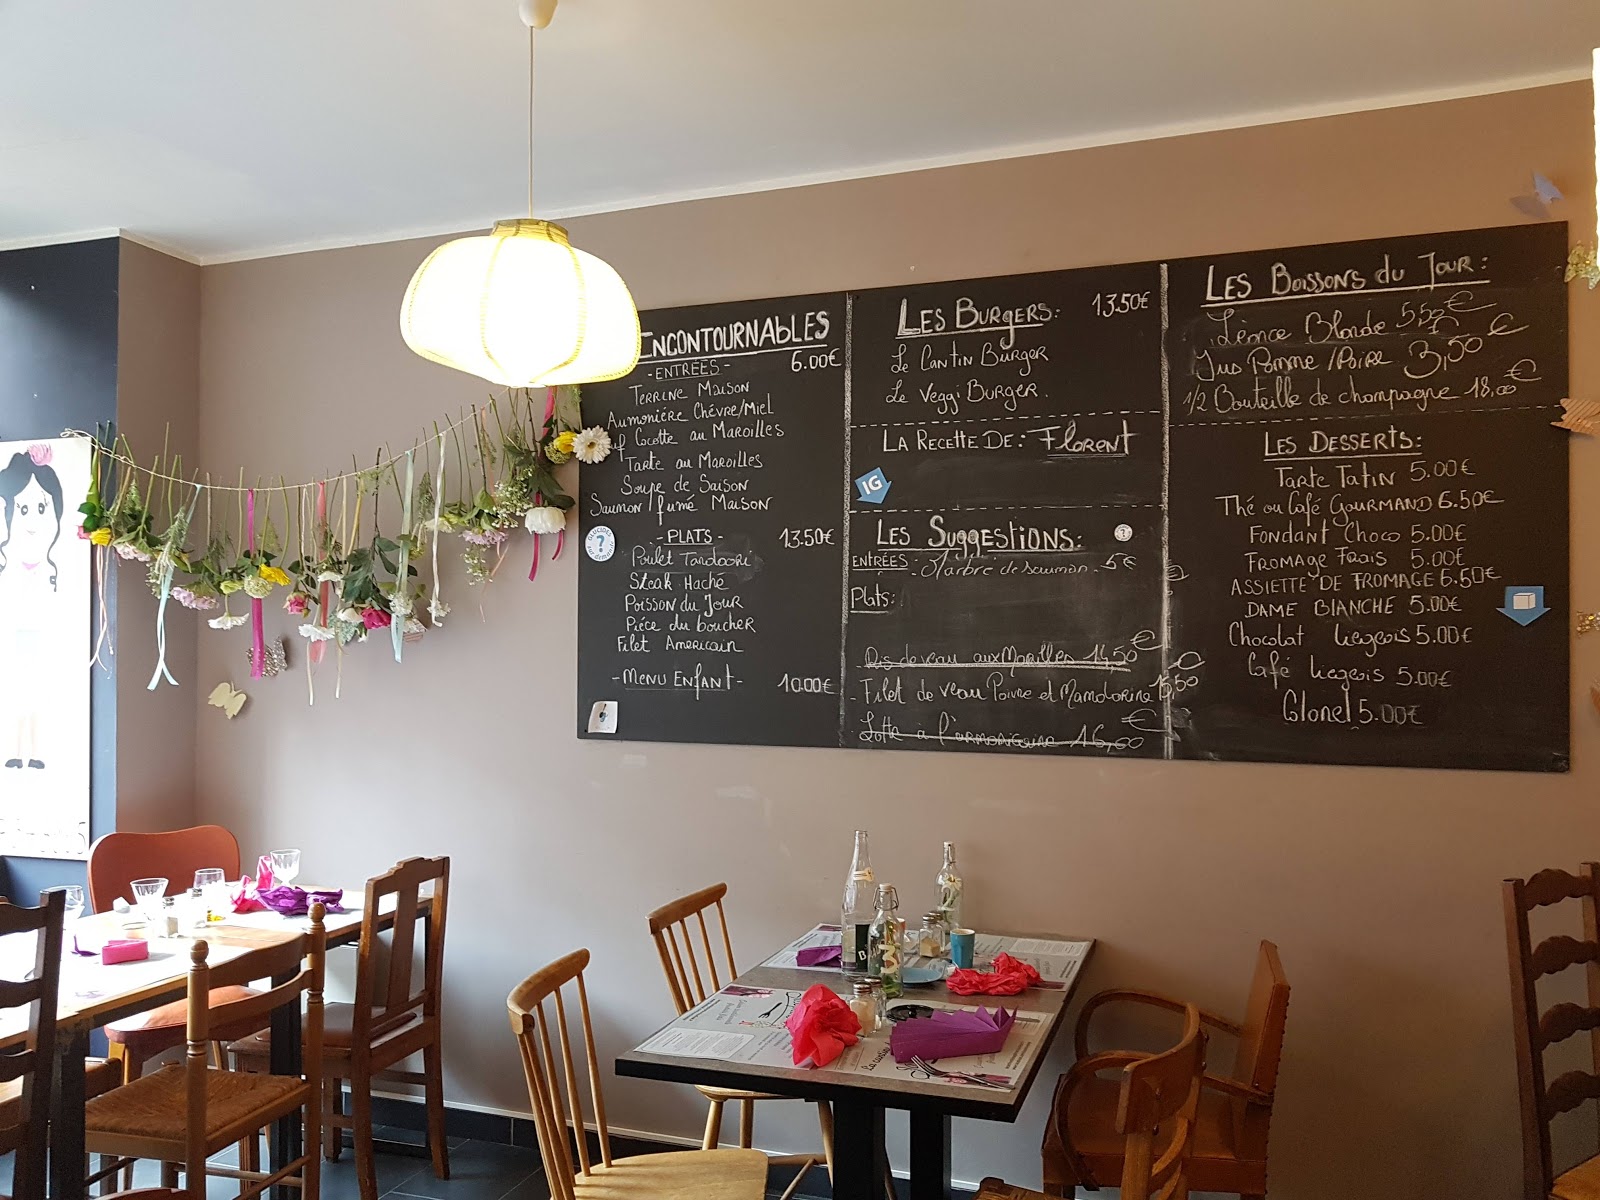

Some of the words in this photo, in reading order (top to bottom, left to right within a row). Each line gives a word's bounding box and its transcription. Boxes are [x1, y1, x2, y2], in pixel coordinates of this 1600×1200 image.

[1206, 264, 1251, 301] LES
[1271, 261, 1366, 295] Boissons
[1375, 253, 1405, 284] du
[897, 298, 945, 337] LES
[1305, 310, 1386, 344] Blonde
[791, 348, 841, 372] 6.00€
[891, 344, 909, 373] Le
[921, 341, 973, 371] Cantin
[981, 342, 1049, 376] Burger
[1196, 349, 1242, 381] Jus
[1247, 346, 1320, 375] Pomme
[698, 381, 750, 397] Maison
[886, 379, 908, 403] Le
[920, 383, 961, 415] Veggi
[1183, 391, 1206, 416] 1/2
[1213, 376, 1301, 414] Bouteille
[1309, 378, 1328, 405] de
[1338, 376, 1459, 412] champagne
[635, 428, 678, 446] Cocotte
[690, 431, 707, 441] au
[713, 421, 784, 439] Maroilles
[1265, 431, 1297, 456] LES
[624, 451, 664, 472] Tarte
[675, 458, 692, 469] au
[698, 451, 763, 469] Maroilles
[1274, 465, 1330, 489] Tarte
[1335, 461, 1396, 487] Tatin
[1409, 458, 1475, 482] 5.00€
[620, 475, 665, 511] Soupe
[673, 474, 690, 492] de
[700, 474, 749, 492] Saison
[862, 475, 883, 494] IG
[590, 493, 642, 517] Saumon
[657, 494, 698, 526] fumé
[711, 494, 773, 511] Maison
[1215, 494, 1255, 515] Thé
[1263, 502, 1285, 514] ou
[1288, 490, 1321, 526] Café
[1438, 489, 1504, 512] 6.50€
[779, 528, 835, 549] 13.50€
[876, 519, 910, 546] LES
[1249, 519, 1328, 544] Fondant
[1344, 521, 1401, 544] Choco
[1410, 523, 1467, 543] 5.00€
[632, 545, 674, 567] Poulet
[1410, 547, 1464, 568] 5.00€
[629, 572, 672, 590] Steak
[684, 572, 729, 590] Haché
[1231, 577, 1307, 597] ASSIETTE
[1320, 576, 1342, 592] DE
[1351, 572, 1434, 591] FROMAGE
[1439, 566, 1502, 588] 6.50€
[625, 594, 676, 612] Poisson
[680, 593, 699, 611] du
[705, 594, 743, 617] Jour
[1244, 602, 1298, 618] DAME
[1409, 595, 1462, 615] 5.00€
[669, 614, 690, 631] du
[696, 612, 756, 633] boucher
[1229, 621, 1305, 647] Chocolat
[1415, 624, 1472, 644] 5.00€
[617, 635, 651, 652] Filet
[1248, 650, 1290, 690] Café
[1395, 667, 1451, 688] 5.00€
[777, 673, 836, 694] 10.00€
[860, 675, 905, 703] Filet
[917, 679, 934, 702] de
[939, 680, 986, 701] veau
[986, 672, 1031, 702] Poivre
[1037, 680, 1056, 702] et
[1359, 698, 1423, 725] 5.00€
[878, 944, 898, 974] 3
